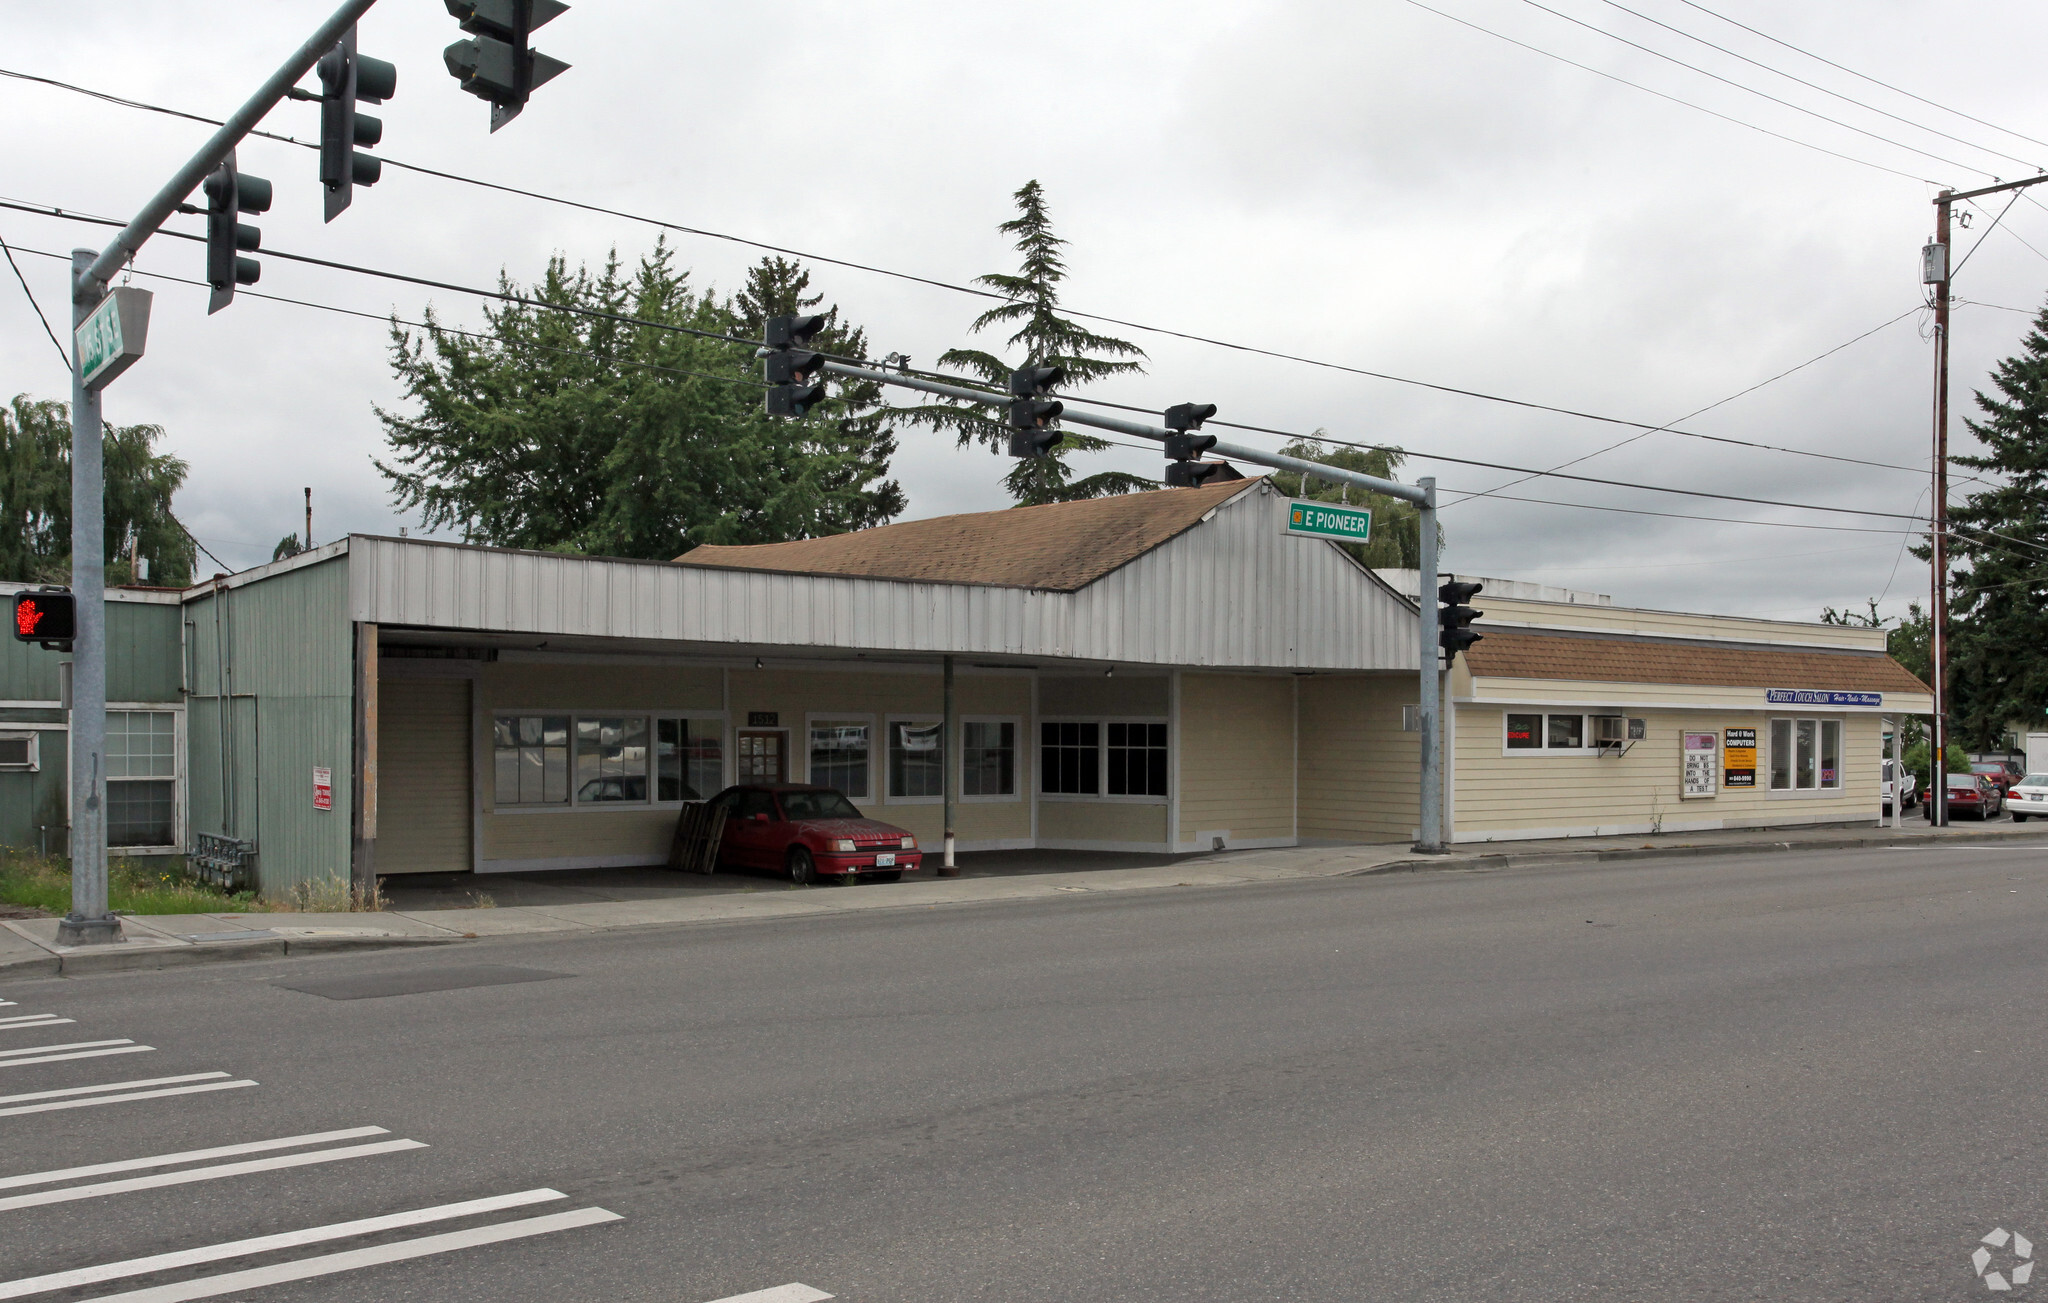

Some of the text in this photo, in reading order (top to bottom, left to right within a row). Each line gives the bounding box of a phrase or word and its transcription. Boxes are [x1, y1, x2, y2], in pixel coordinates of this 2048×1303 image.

[106, 311, 119, 343] SE
[1305, 510, 1365, 533] E PIONEER
[1769, 690, 1794, 702] PERFECT
[1794, 691, 1813, 702] TOUCH
[1812, 691, 1830, 703] SALON
[1507, 731, 1530, 739] EDICURE
[1726, 739, 1755, 747] COMPUTERS
